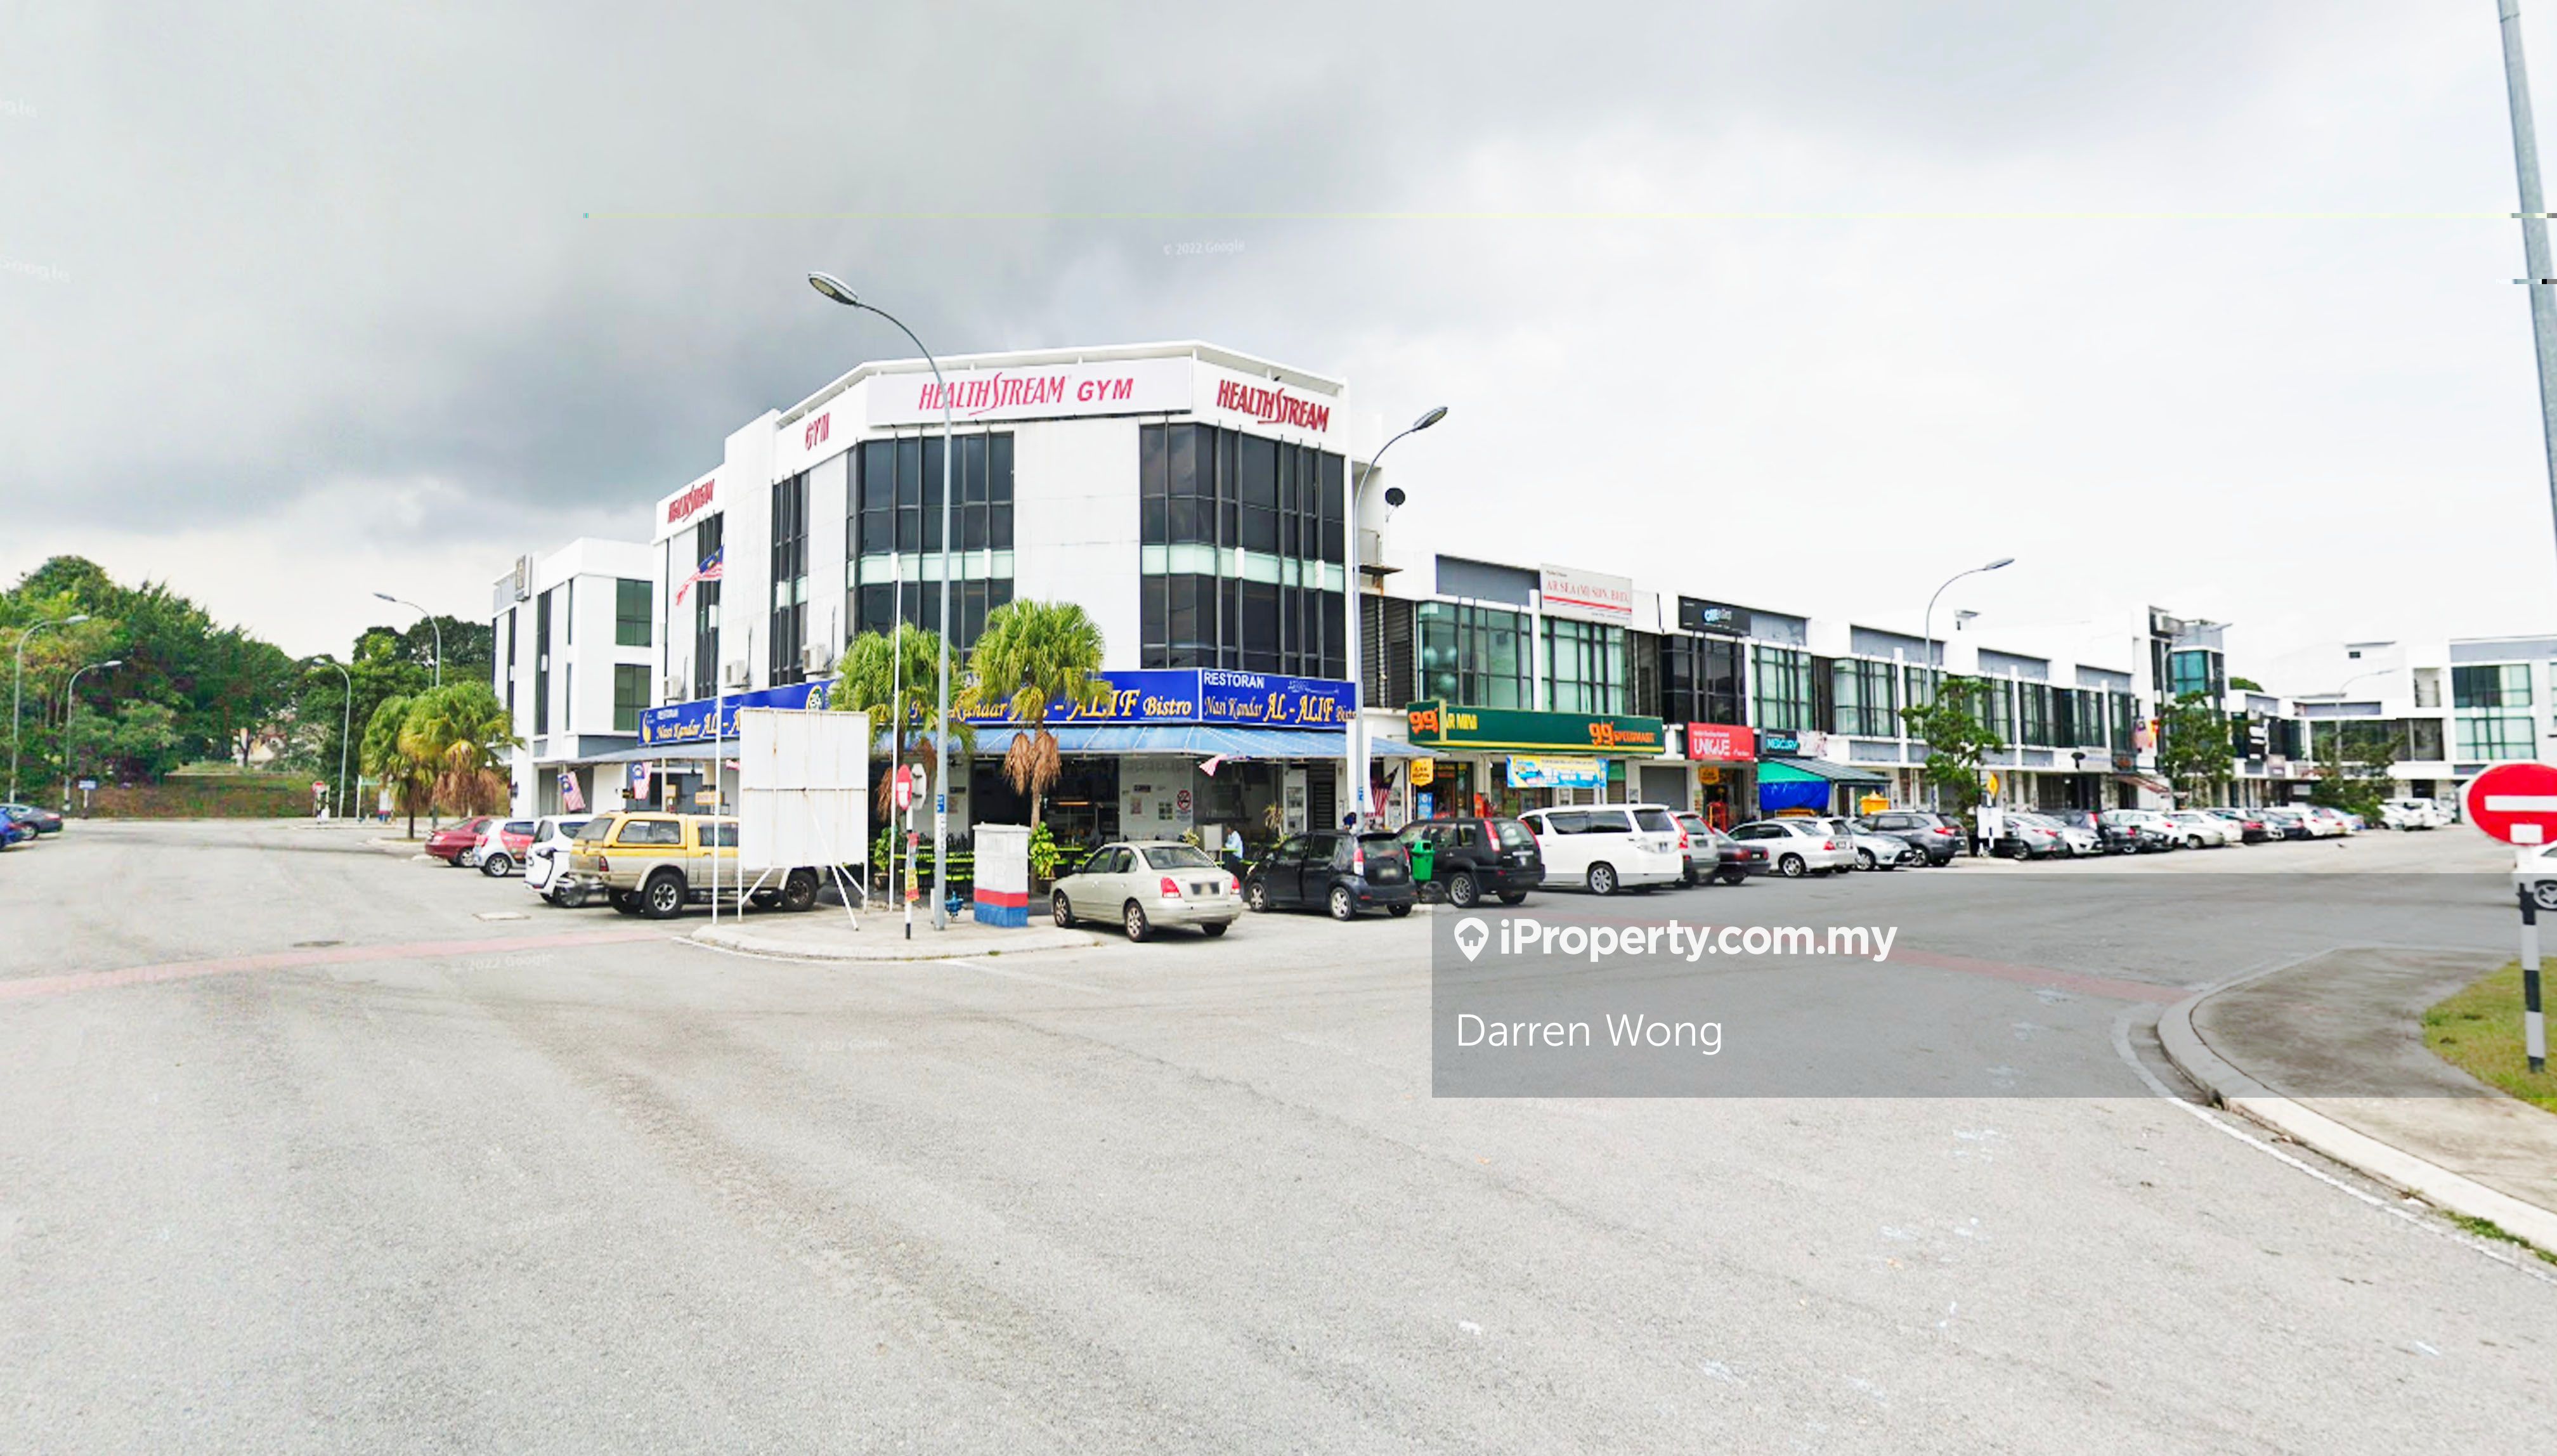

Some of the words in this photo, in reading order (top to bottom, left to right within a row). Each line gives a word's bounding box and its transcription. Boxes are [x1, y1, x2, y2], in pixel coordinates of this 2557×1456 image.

[1077, 378, 1134, 402] GYM
[1217, 379, 1330, 432] HEALTHSTREAM
[805, 412, 830, 451] GYM
[1204, 672, 1265, 689] RESTORAN
[1143, 695, 1192, 717] Bistro
[1228, 696, 1263, 720] Kandar
[1263, 692, 1286, 722] AL
[1295, 695, 1334, 724] ALIF
[1409, 710, 1438, 734] 99
[1589, 721, 1615, 748] 99
[1694, 738, 1731, 756] UNIQUE
